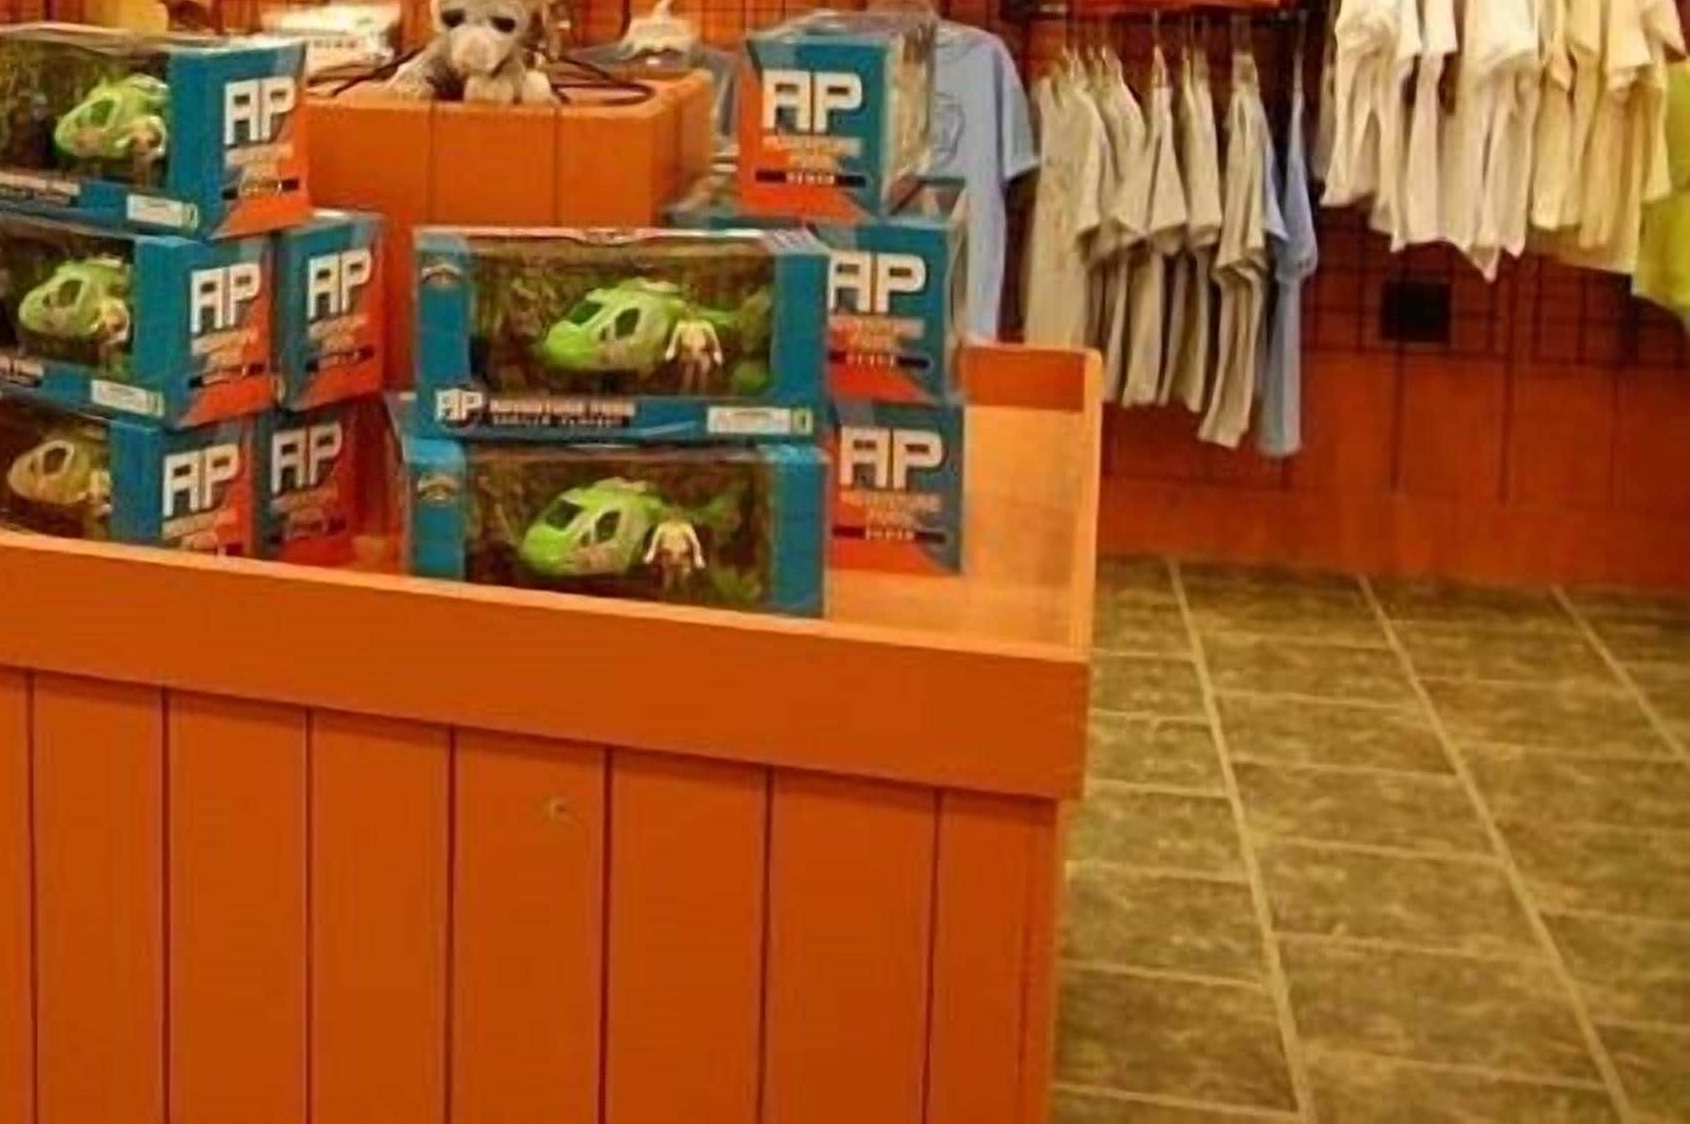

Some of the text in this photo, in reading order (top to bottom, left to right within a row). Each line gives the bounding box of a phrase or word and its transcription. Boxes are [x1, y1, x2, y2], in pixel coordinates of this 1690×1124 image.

[224, 77, 295, 145] AP
[762, 69, 862, 133] AP
[190, 263, 261, 334] AP
[307, 249, 373, 319] AP
[828, 250, 926, 313] AP
[162, 443, 239, 517] AP
[271, 423, 342, 494] AP
[840, 426, 943, 489] AP
